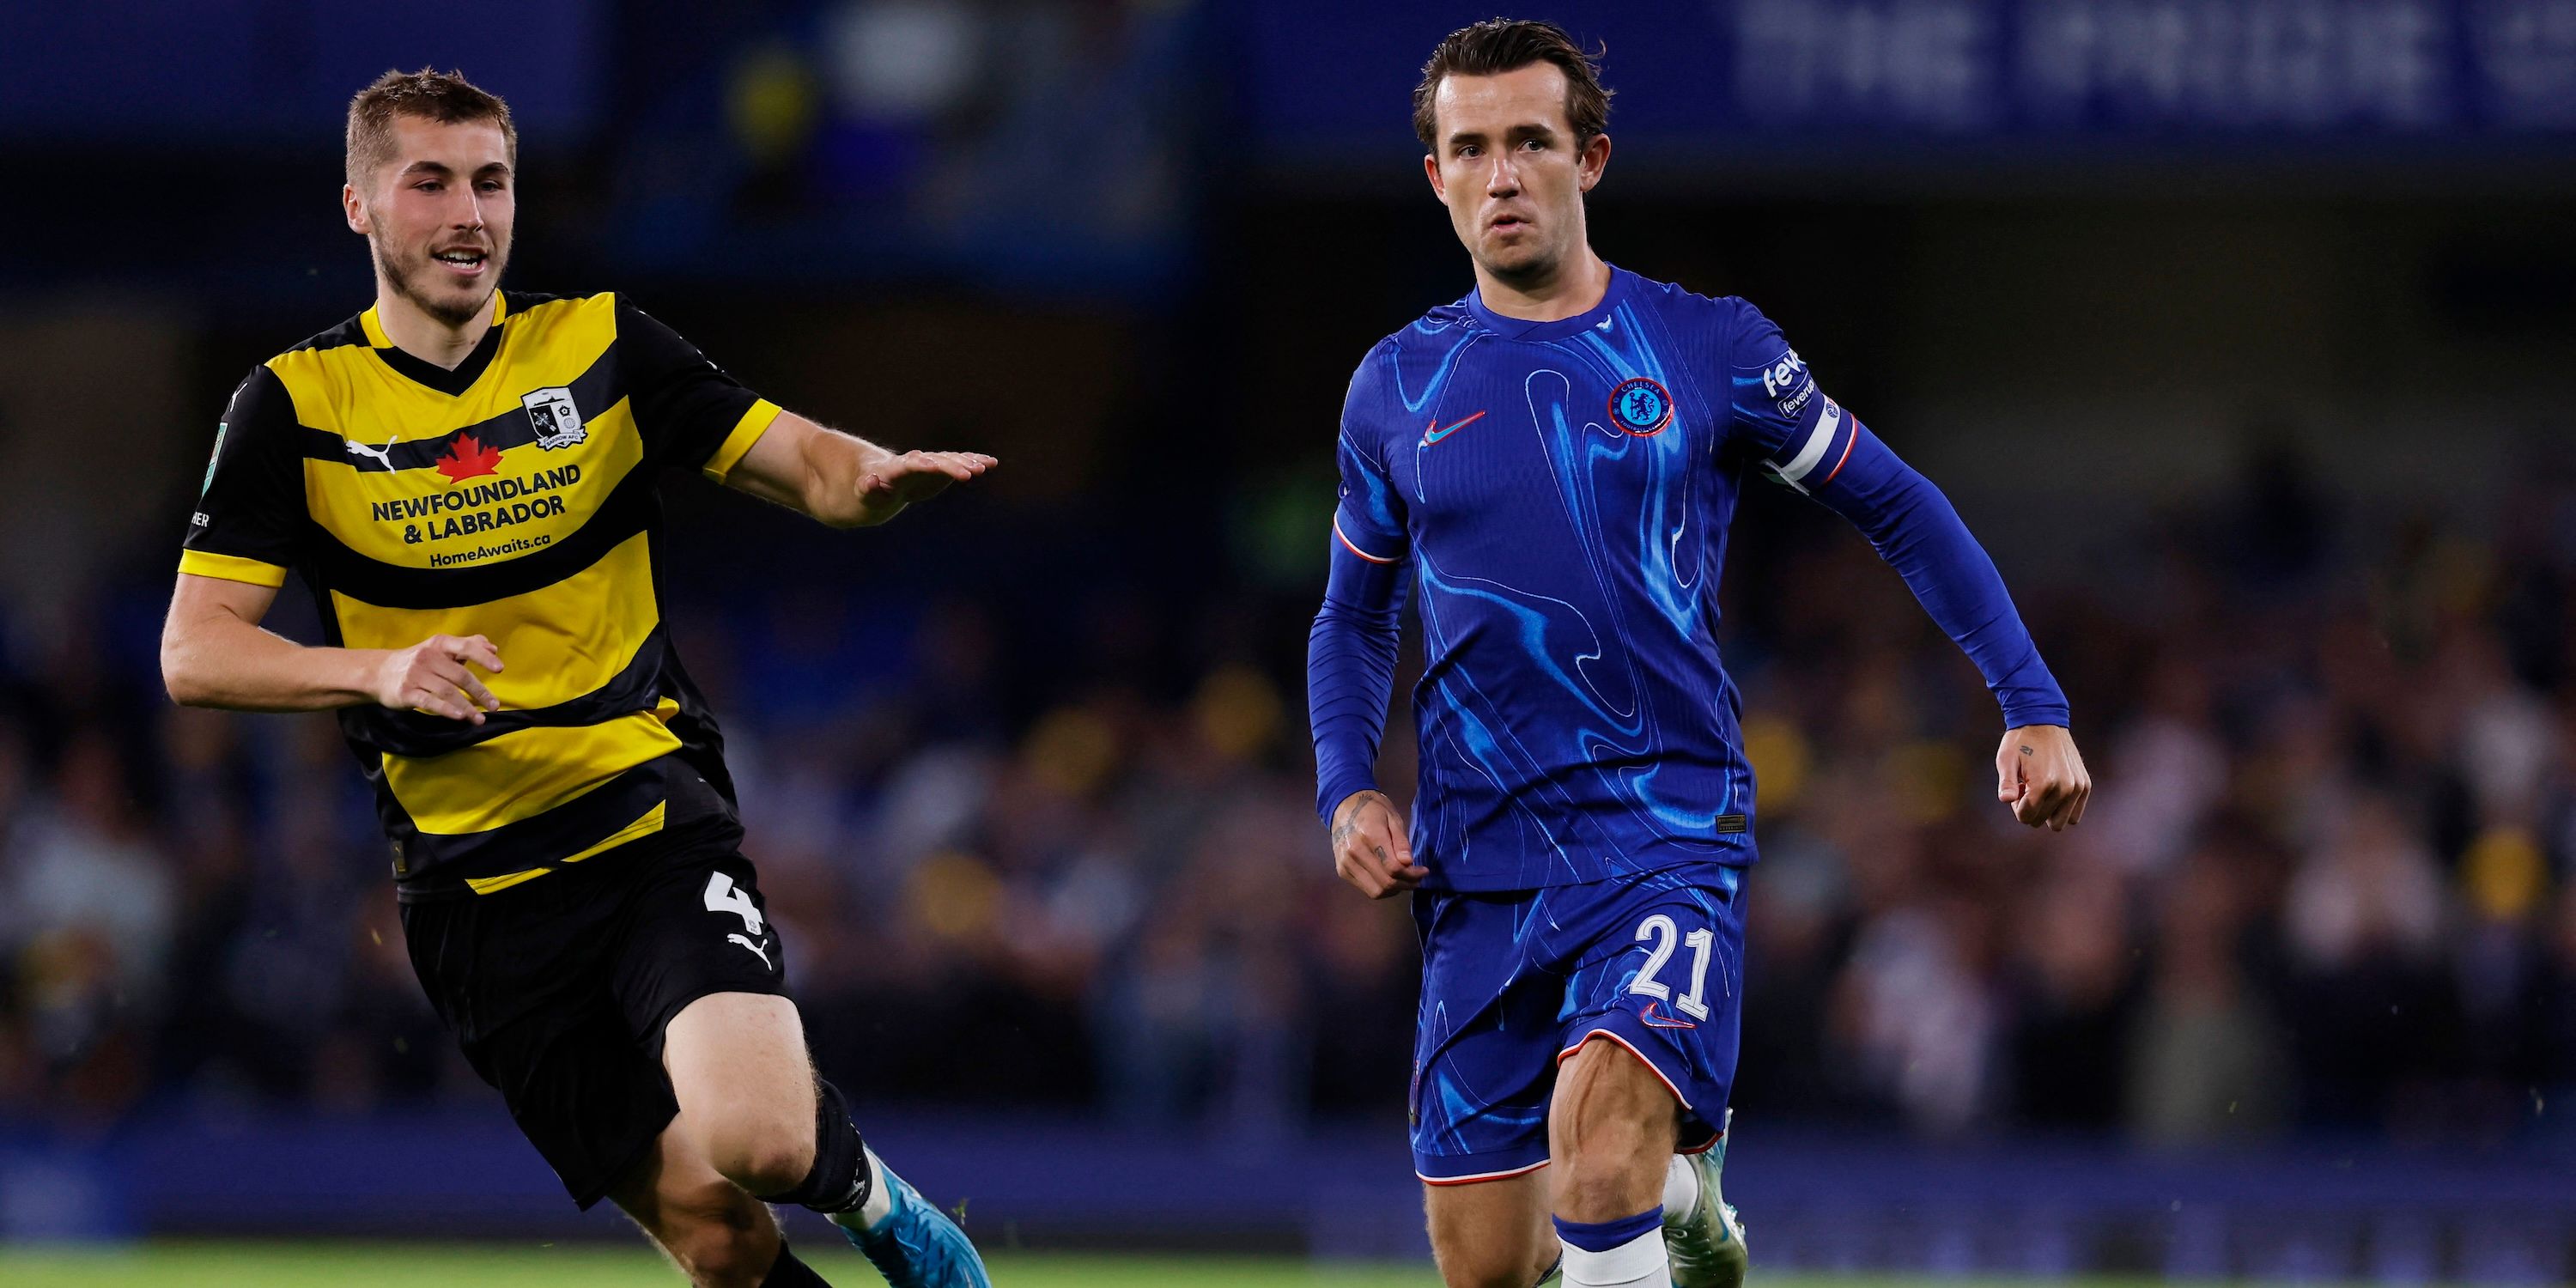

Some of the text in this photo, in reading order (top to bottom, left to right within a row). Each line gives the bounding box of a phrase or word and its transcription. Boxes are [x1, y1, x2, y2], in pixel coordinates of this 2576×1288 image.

[1621, 381, 1661, 395] CHELSEA
[372, 465, 581, 522] NEWFOUNDLAND
[404, 495, 566, 544] & LABRADOR
[430, 534, 551, 568] HomeAwaits.ca
[704, 871, 763, 935] 4
[1629, 914, 1714, 1022] 21
